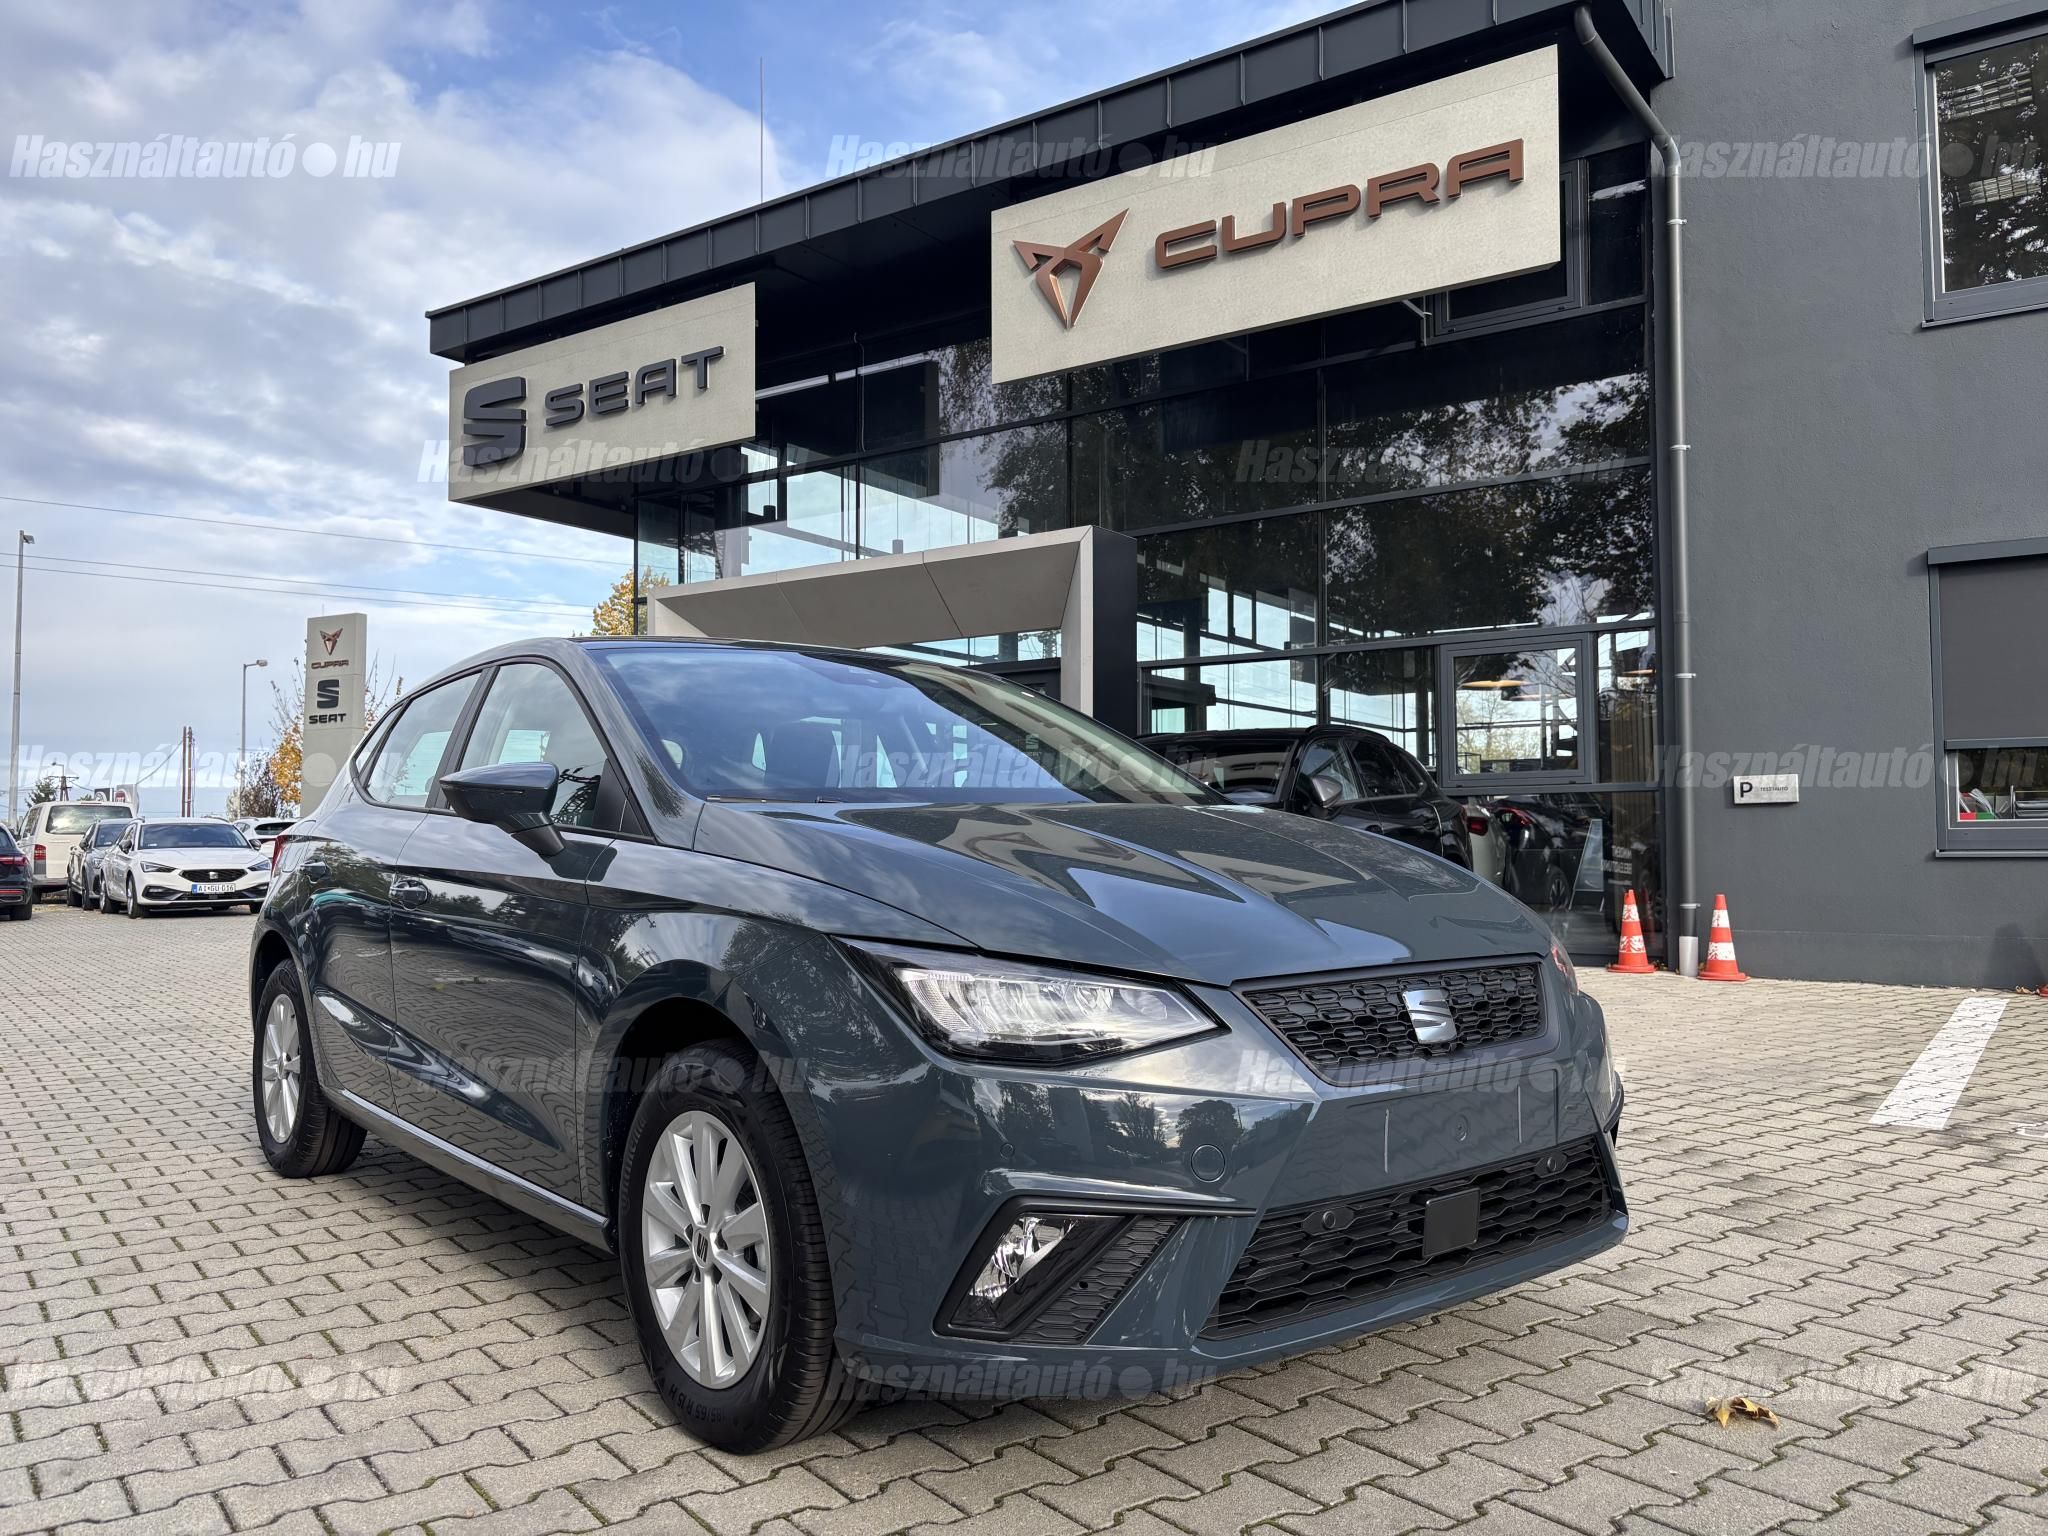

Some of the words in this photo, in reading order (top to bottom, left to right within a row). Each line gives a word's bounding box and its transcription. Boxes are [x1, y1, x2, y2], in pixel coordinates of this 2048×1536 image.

[1154, 138, 1525, 270] CUPRA
[544, 346, 725, 427] SEAT
[309, 713, 347, 724] SEAT
[1740, 781, 1753, 798] P
